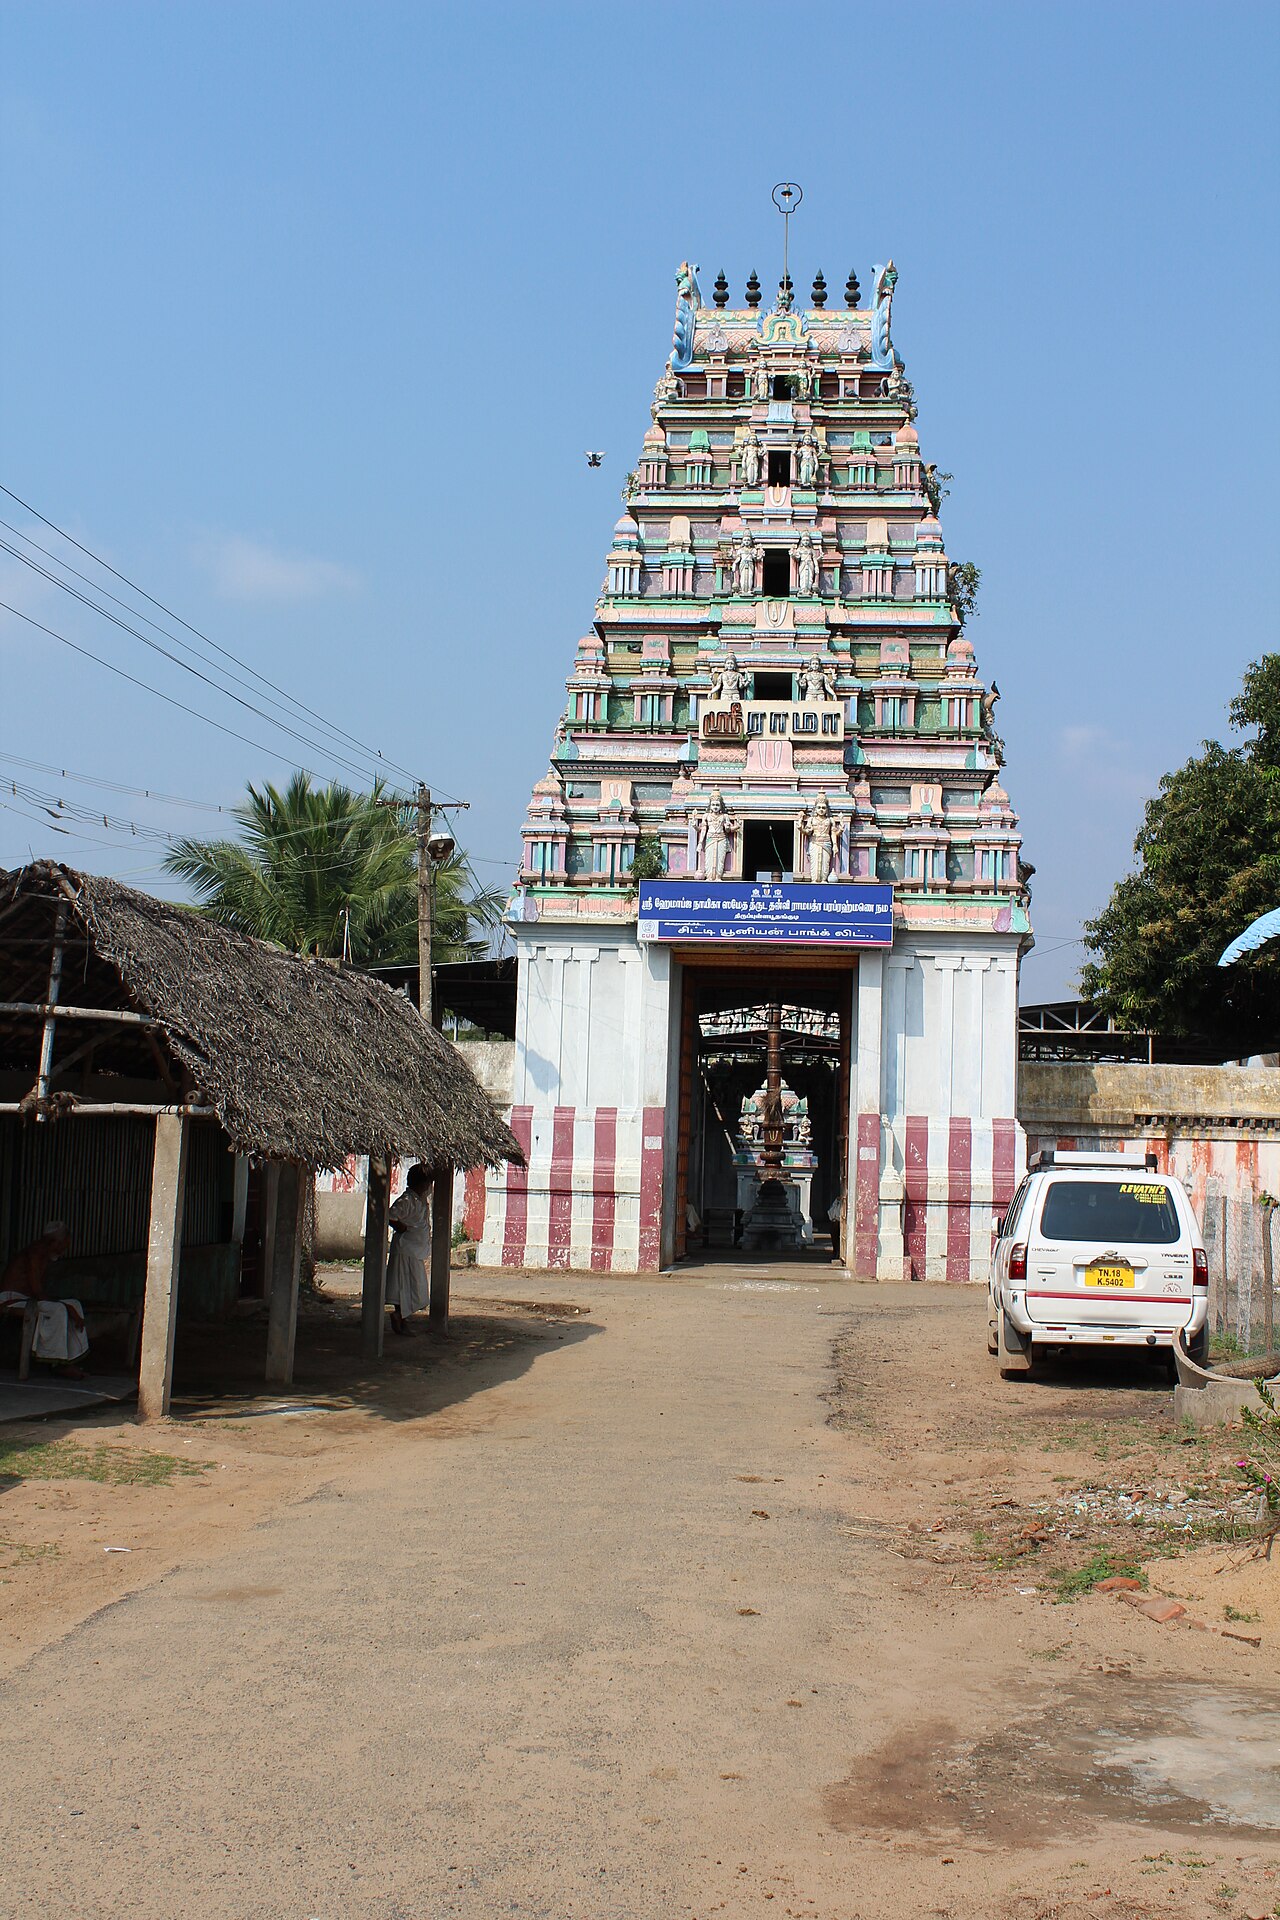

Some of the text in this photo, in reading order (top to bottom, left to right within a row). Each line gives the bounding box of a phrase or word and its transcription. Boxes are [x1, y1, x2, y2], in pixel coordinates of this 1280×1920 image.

[746, 711, 841, 736] ராமா
[692, 897, 721, 911] நாயிகா
[678, 925, 716, 936] சிட்டி
[720, 927, 784, 937] யூனியன்
[788, 928, 831, 937] பாங்க்
[1119, 1184, 1166, 1194] REVATHI'S
[1098, 1268, 1121, 1277] TN.18
[1097, 1277, 1124, 1287] K.5402
